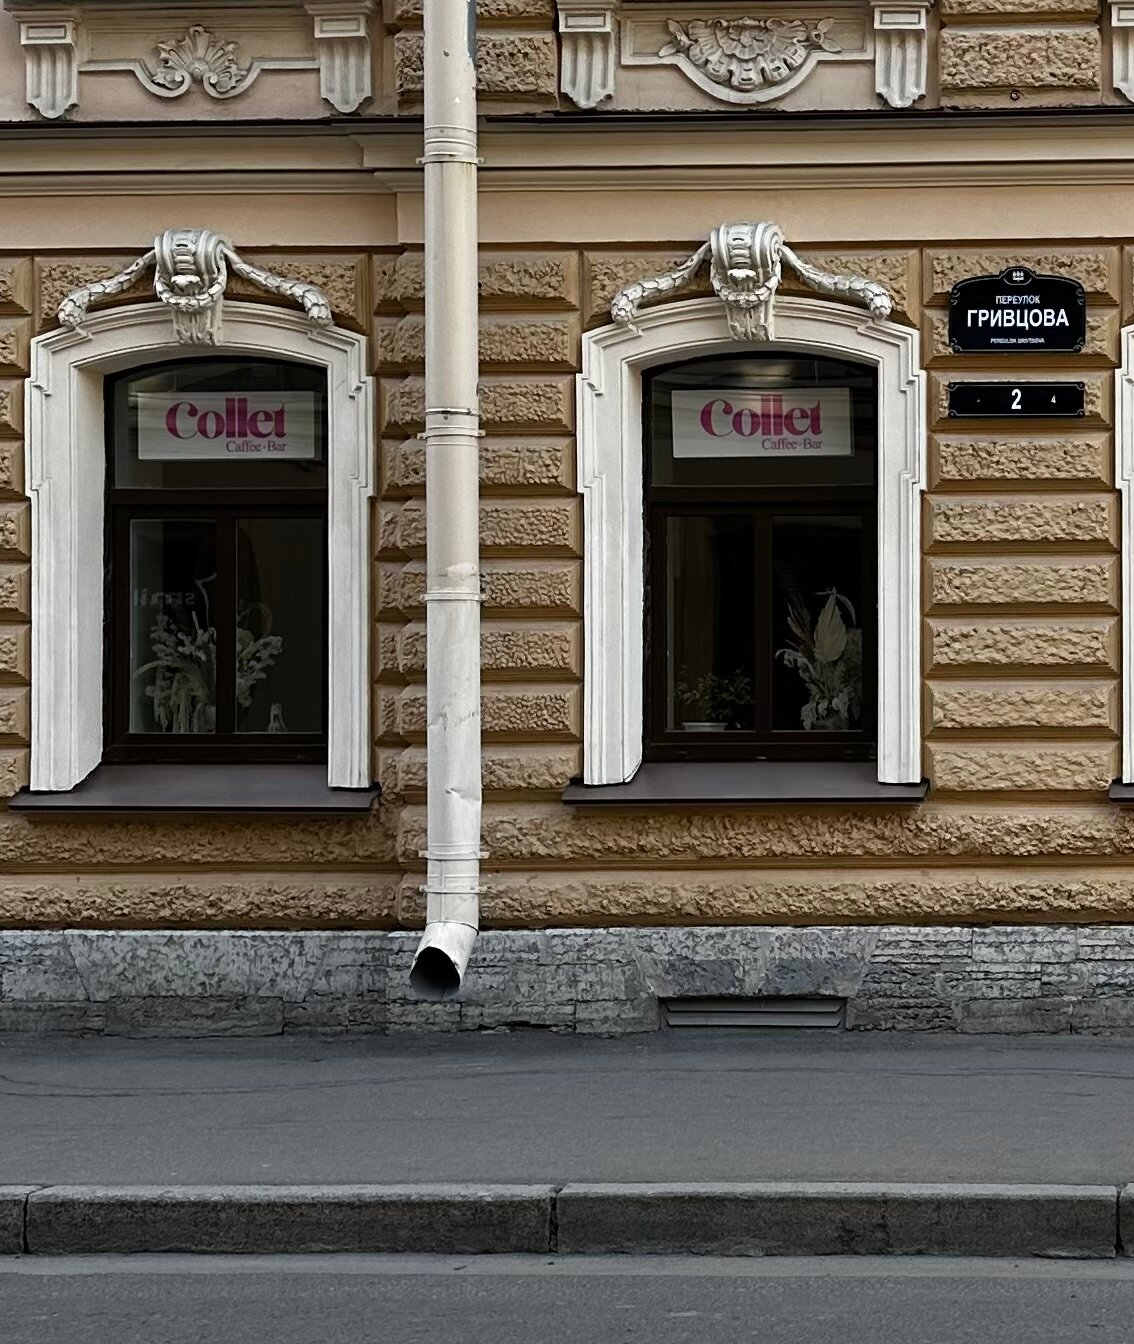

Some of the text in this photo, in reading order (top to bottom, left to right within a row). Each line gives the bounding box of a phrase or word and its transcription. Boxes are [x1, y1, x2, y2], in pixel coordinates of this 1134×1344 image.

[995, 295, 1041, 305] ПЕРЕУЛОК
[967, 308, 1070, 331] ГРИВЦОВА
[1011, 388, 1057, 410] 2 4
[165, 397, 288, 440] Collet
[700, 393, 823, 438] Collet
